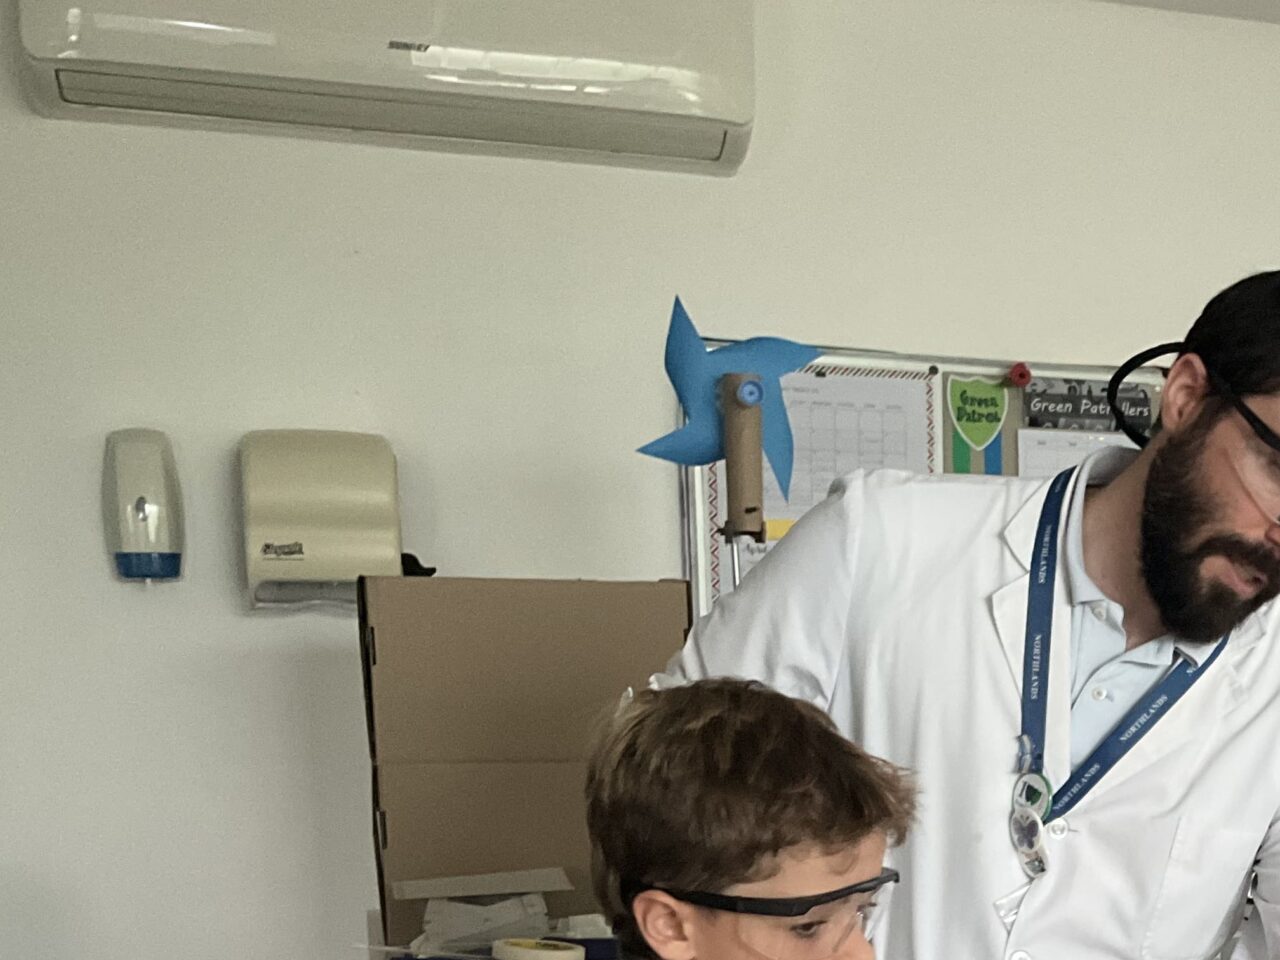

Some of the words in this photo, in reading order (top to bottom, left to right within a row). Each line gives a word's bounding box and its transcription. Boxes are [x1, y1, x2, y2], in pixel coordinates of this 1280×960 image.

[960, 389, 999, 408] Green
[1030, 398, 1073, 413] Green
[1080, 400, 1149, 417] Patrllers
[1038, 524, 1052, 585] NORTHLANDS
[1030, 634, 1043, 700] NORTHLANDS
[1119, 694, 1168, 743] NORTHLANDS
[1052, 763, 1100, 812] NORTHLANDS
